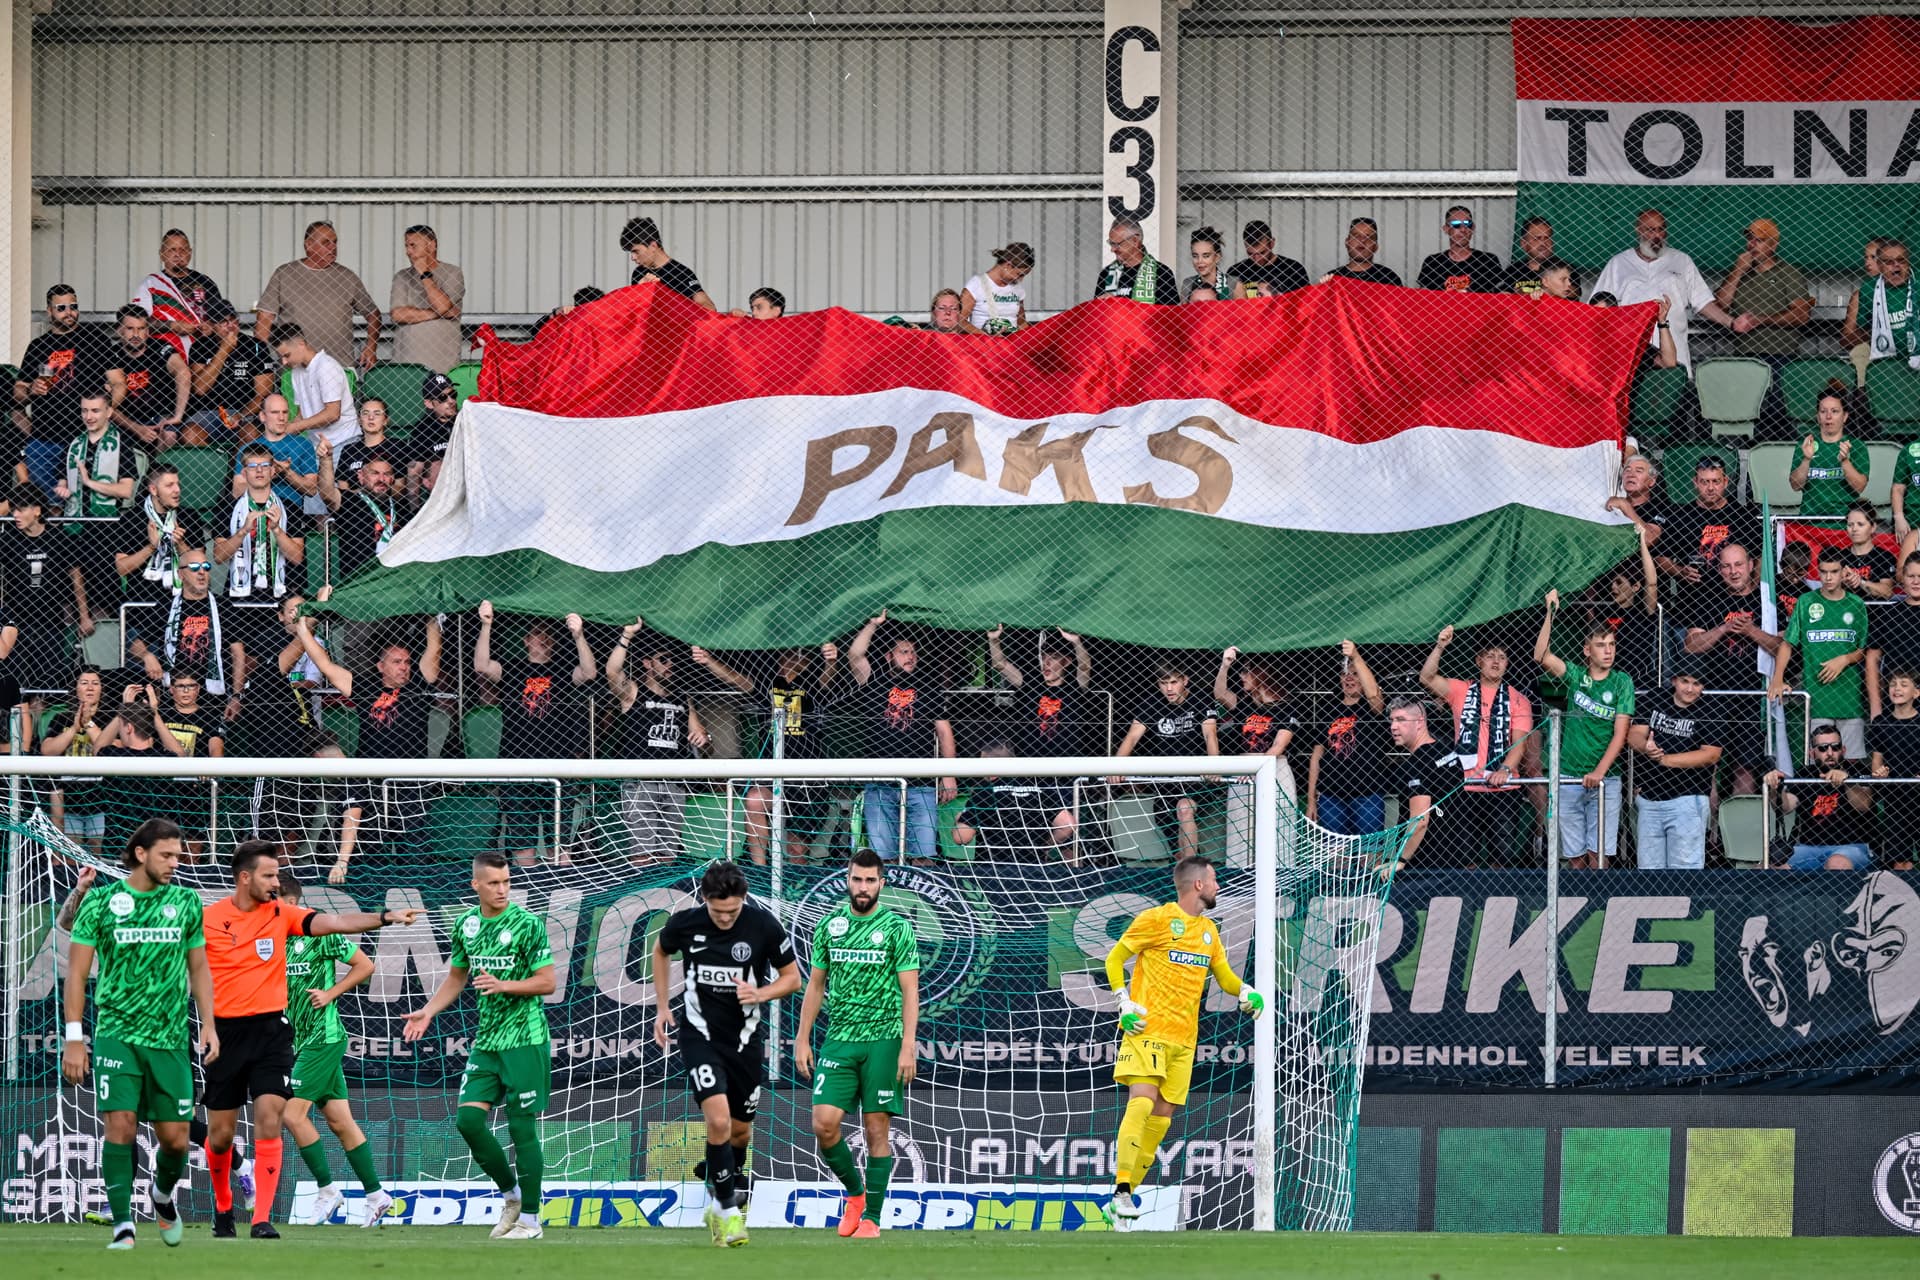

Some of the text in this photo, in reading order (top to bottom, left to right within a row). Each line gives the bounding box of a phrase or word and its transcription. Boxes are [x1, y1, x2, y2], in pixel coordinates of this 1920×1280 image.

[1106, 26, 1160, 122] C
[1108, 126, 1155, 222] 3
[784, 411, 1240, 527] PAKS
[701, 969, 738, 983] BGV
[1151, 1054, 1158, 1070] 1
[100, 1074, 110, 1100] 5
[690, 1063, 716, 1092] 18
[814, 1073, 825, 1095] 2
[1025, 1137, 1254, 1177] MAYAR
